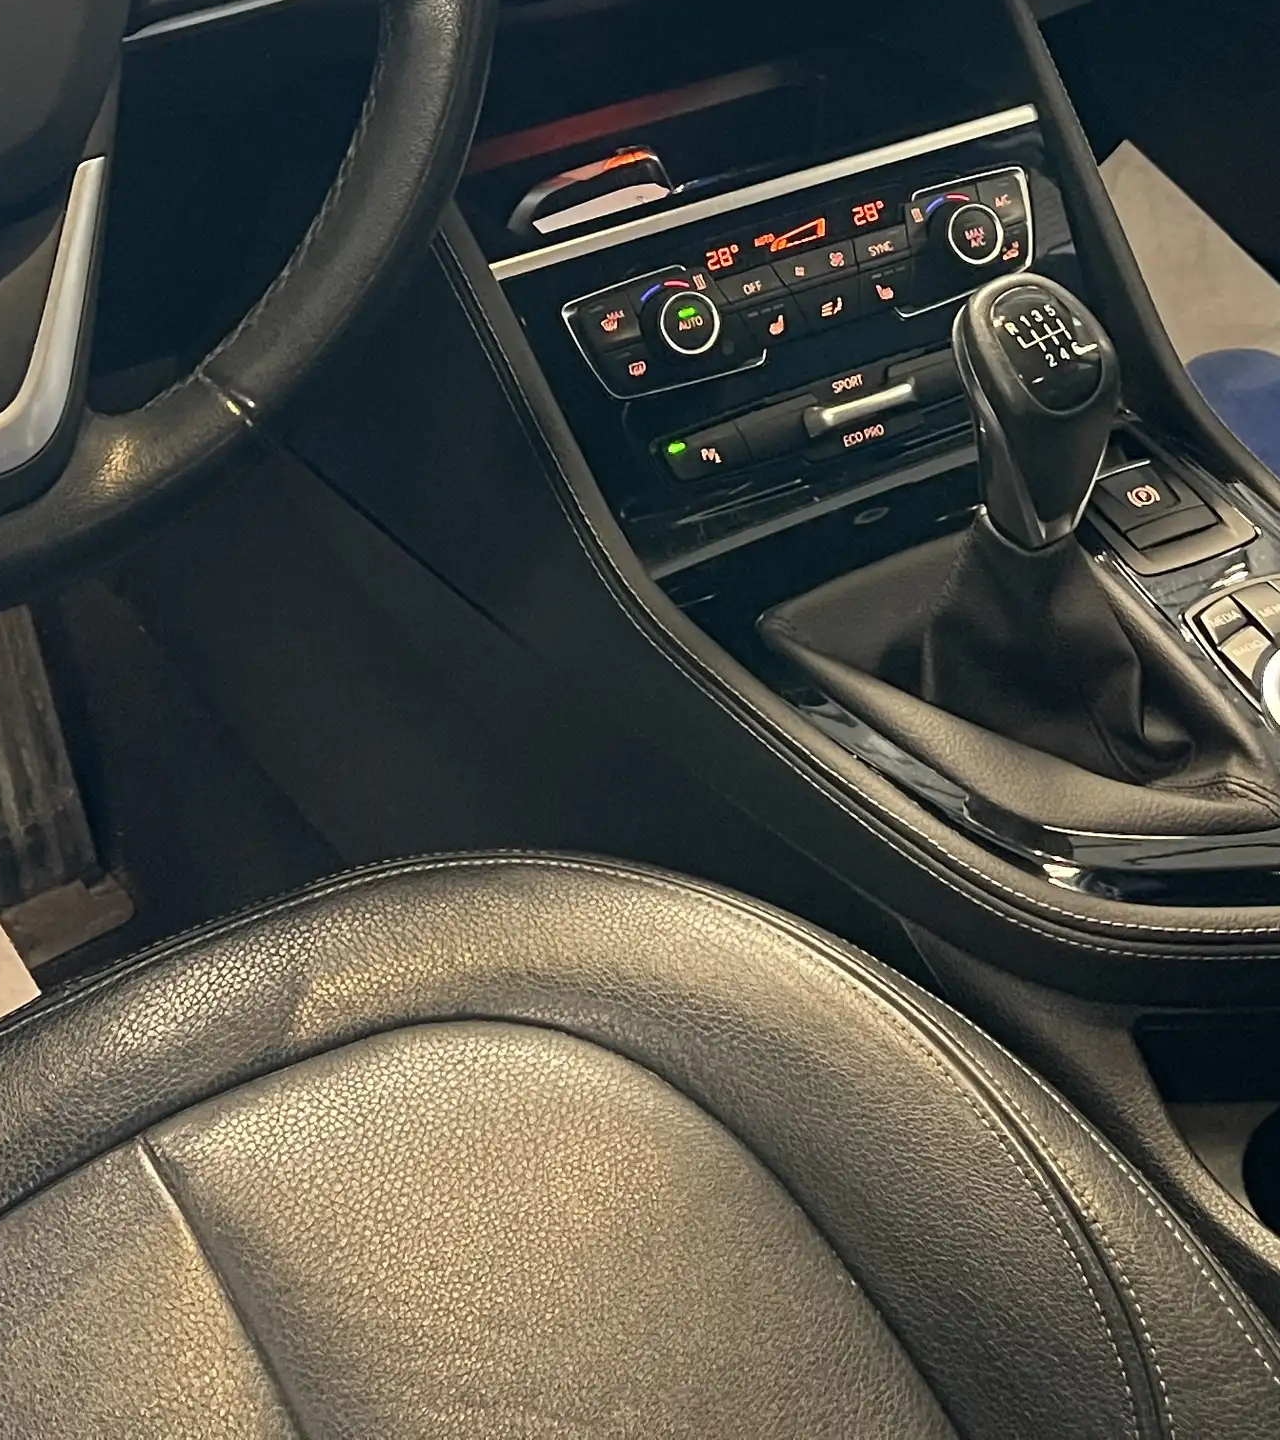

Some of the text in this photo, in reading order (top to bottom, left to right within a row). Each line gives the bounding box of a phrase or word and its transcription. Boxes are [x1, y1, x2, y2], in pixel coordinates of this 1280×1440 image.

[994, 194, 1012, 208] A/C
[964, 226, 986, 241] MAX
[868, 240, 894, 257] SYNC
[969, 236, 987, 249] A/C
[742, 280, 763, 295] OFF
[678, 315, 704, 331] AUTO
[1004, 304, 1056, 335] R 1 3 5
[1045, 353, 1058, 368] 2
[1059, 347, 1070, 360] 4
[831, 373, 864, 394] SPORT
[842, 424, 885, 448] ECO PRO
[1207, 610, 1241, 628] MEDIA
